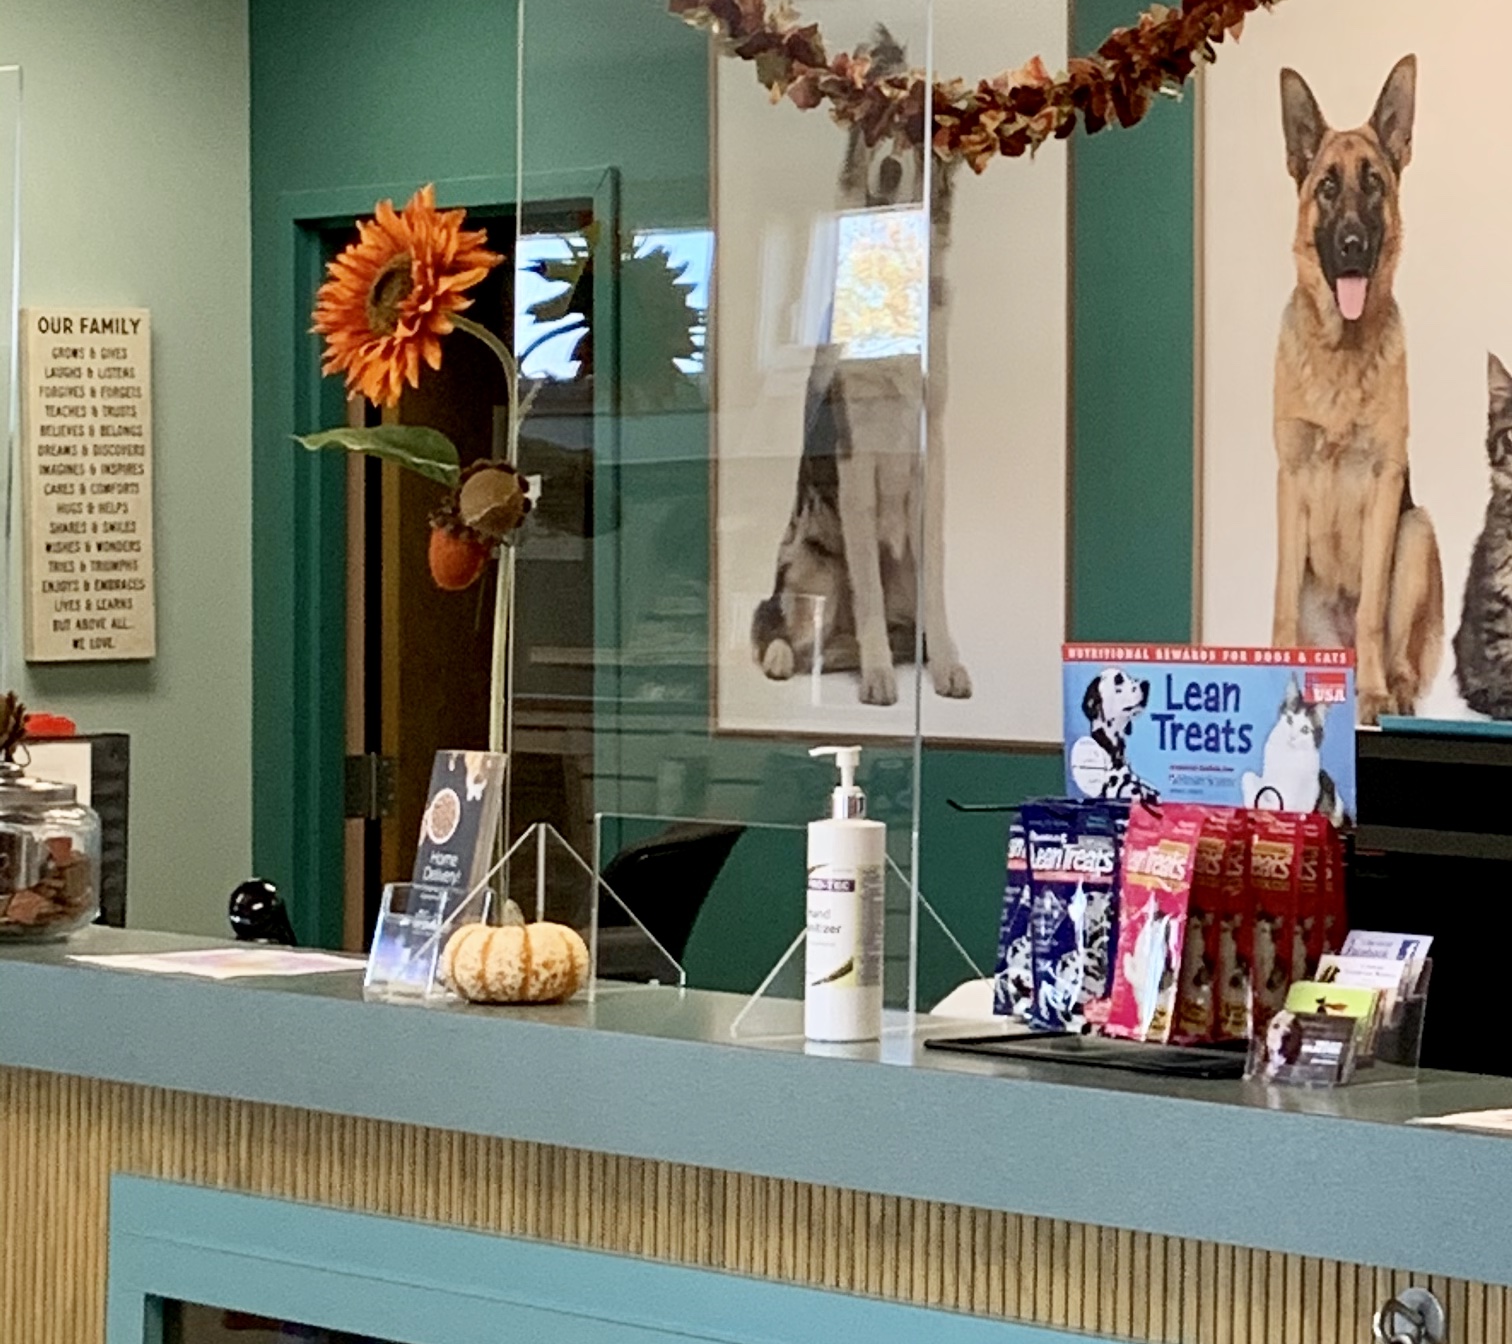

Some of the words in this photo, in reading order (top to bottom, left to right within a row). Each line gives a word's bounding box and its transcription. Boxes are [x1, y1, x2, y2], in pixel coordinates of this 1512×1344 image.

[38, 316, 73, 334] OUR
[80, 317, 142, 335] FAMILY
[53, 619, 70, 631] BUT
[73, 638, 85, 650] WE
[1068, 647, 1149, 661] NUTRITIONAL
[1156, 648, 1216, 662] REWARDS
[1223, 650, 1247, 662] FOR
[1254, 651, 1291, 663] DOGS
[1299, 652, 1307, 663] &
[1314, 652, 1347, 664] CATS
[1166, 673, 1241, 713] Lean
[1313, 687, 1346, 702] USA
[1151, 714, 1253, 754] Treats
